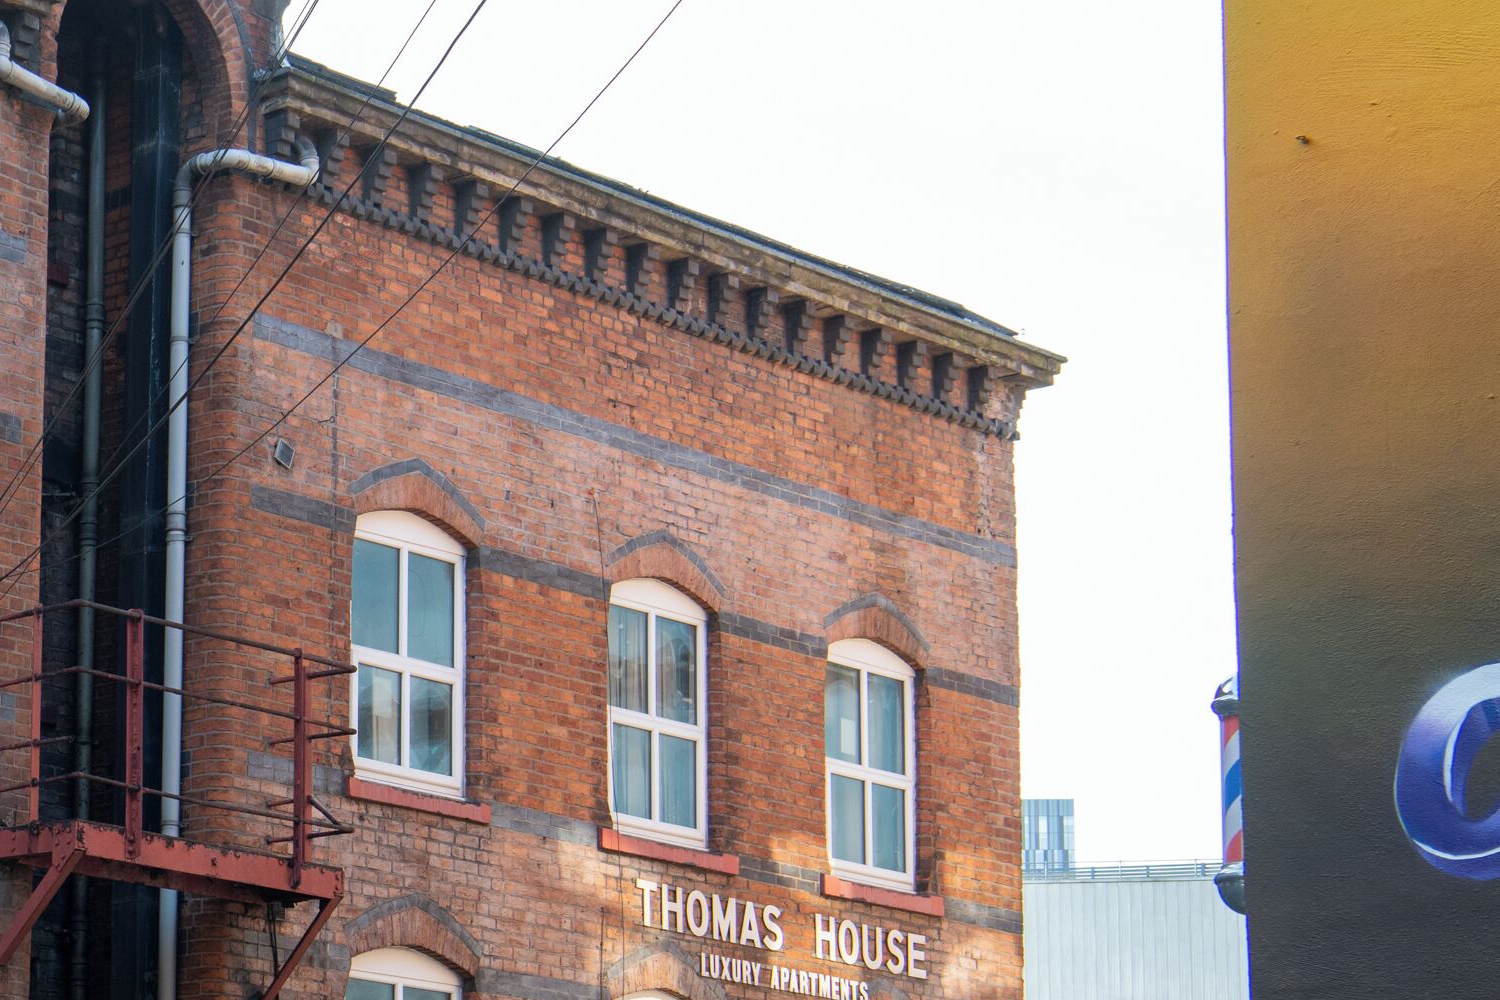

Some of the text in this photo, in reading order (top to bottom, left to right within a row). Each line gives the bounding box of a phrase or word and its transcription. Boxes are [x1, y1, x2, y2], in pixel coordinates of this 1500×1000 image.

[636, 878, 928, 979] THOMAS HOUSE
[701, 953, 761, 986] LUXURY
